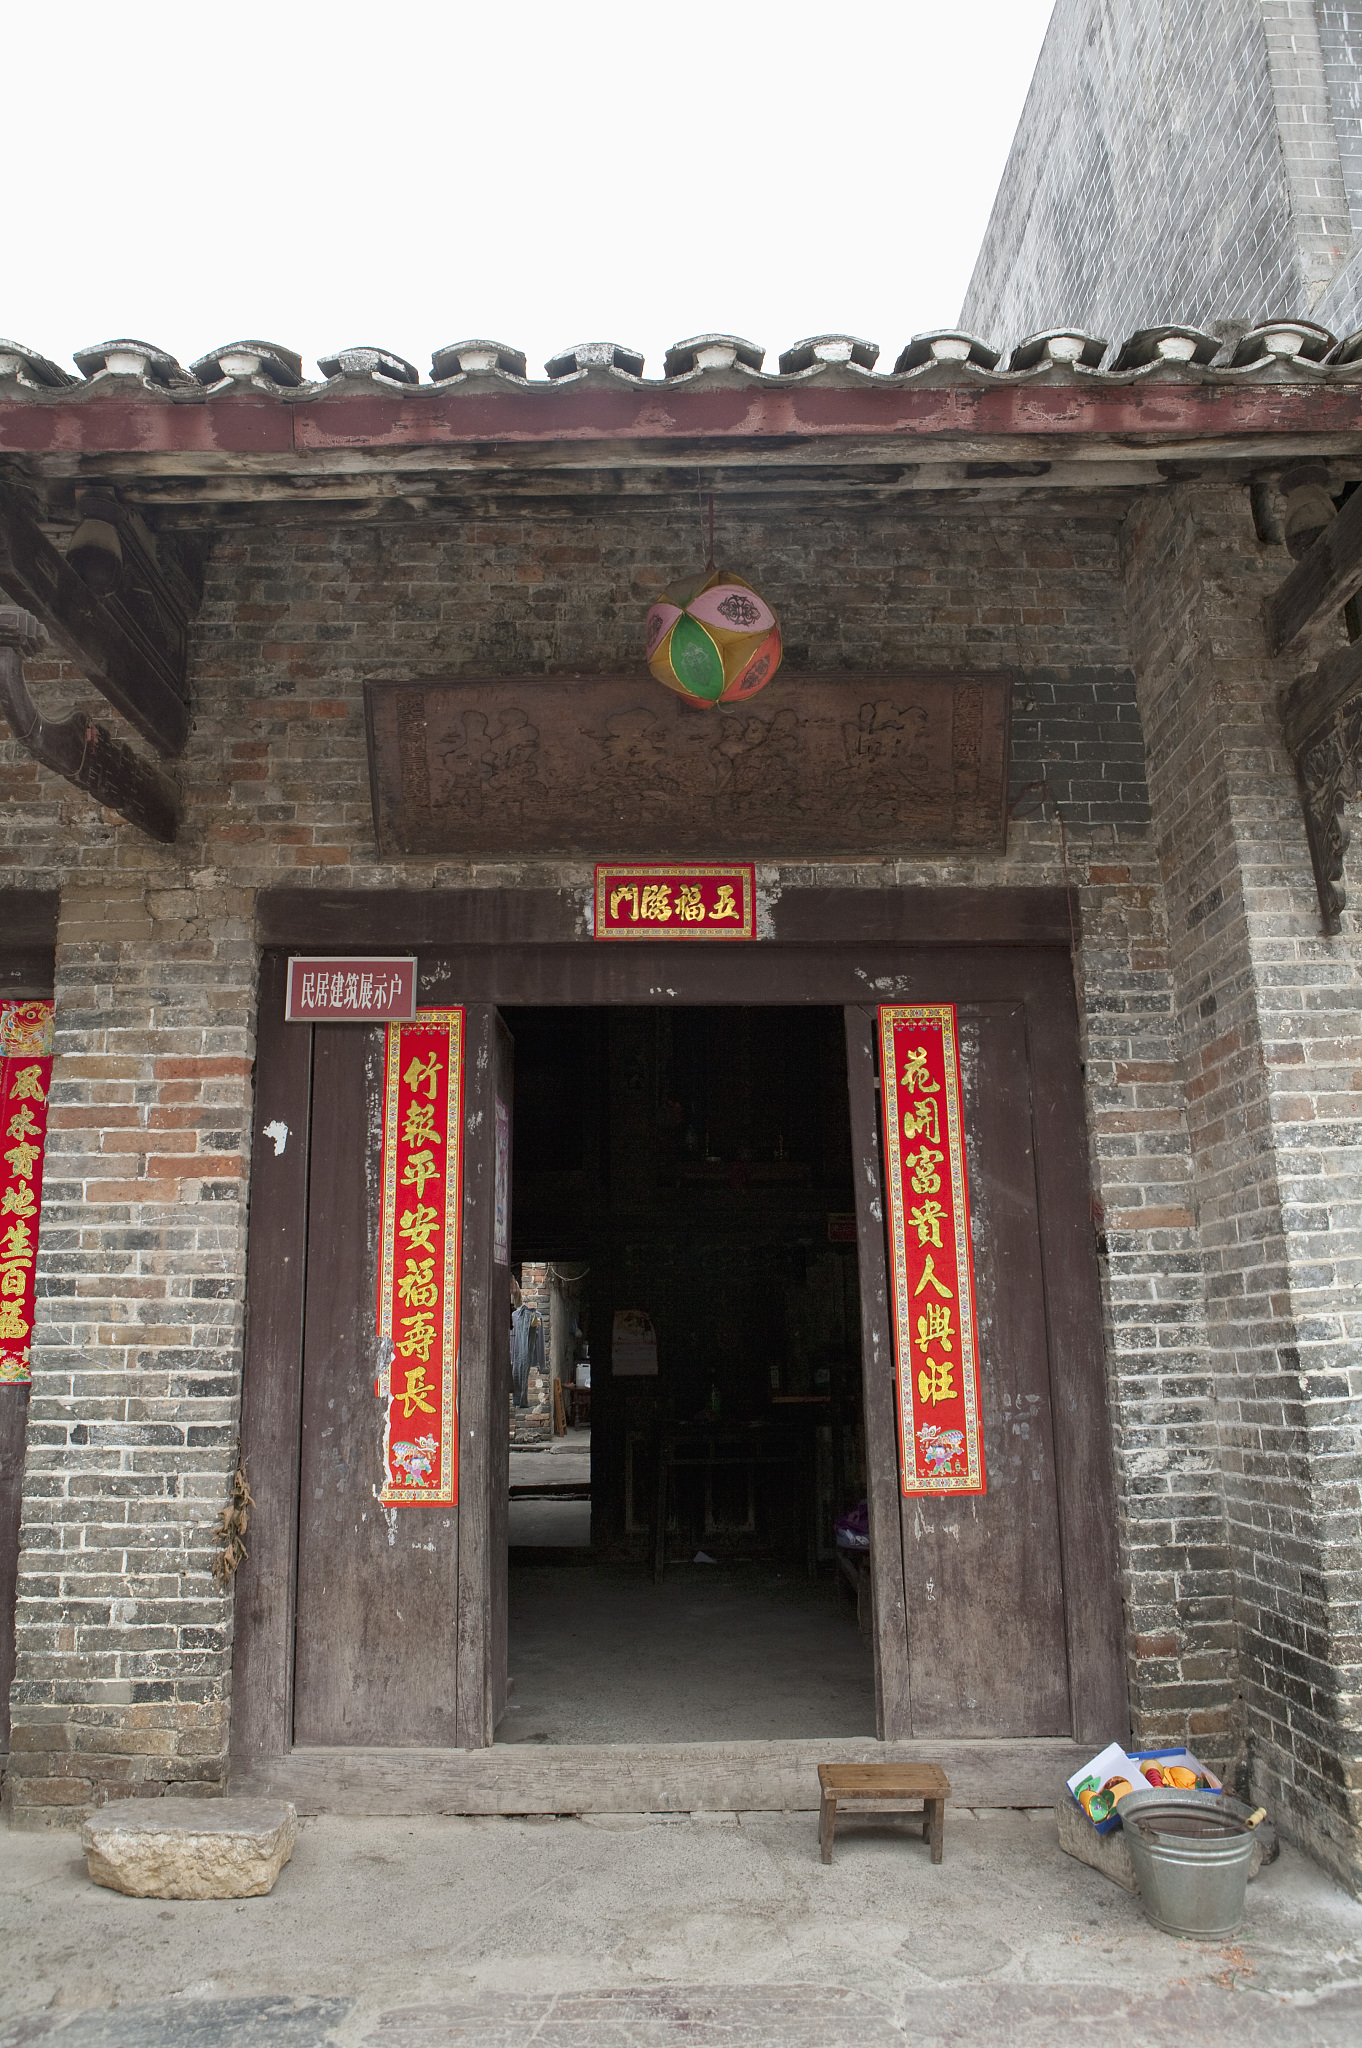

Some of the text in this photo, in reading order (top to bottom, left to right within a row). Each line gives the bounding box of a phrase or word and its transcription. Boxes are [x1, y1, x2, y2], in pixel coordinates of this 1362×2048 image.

[301, 971, 403, 1010] 民居建筑展示户
[395, 1051, 444, 1418] 竹報平安福壽長
